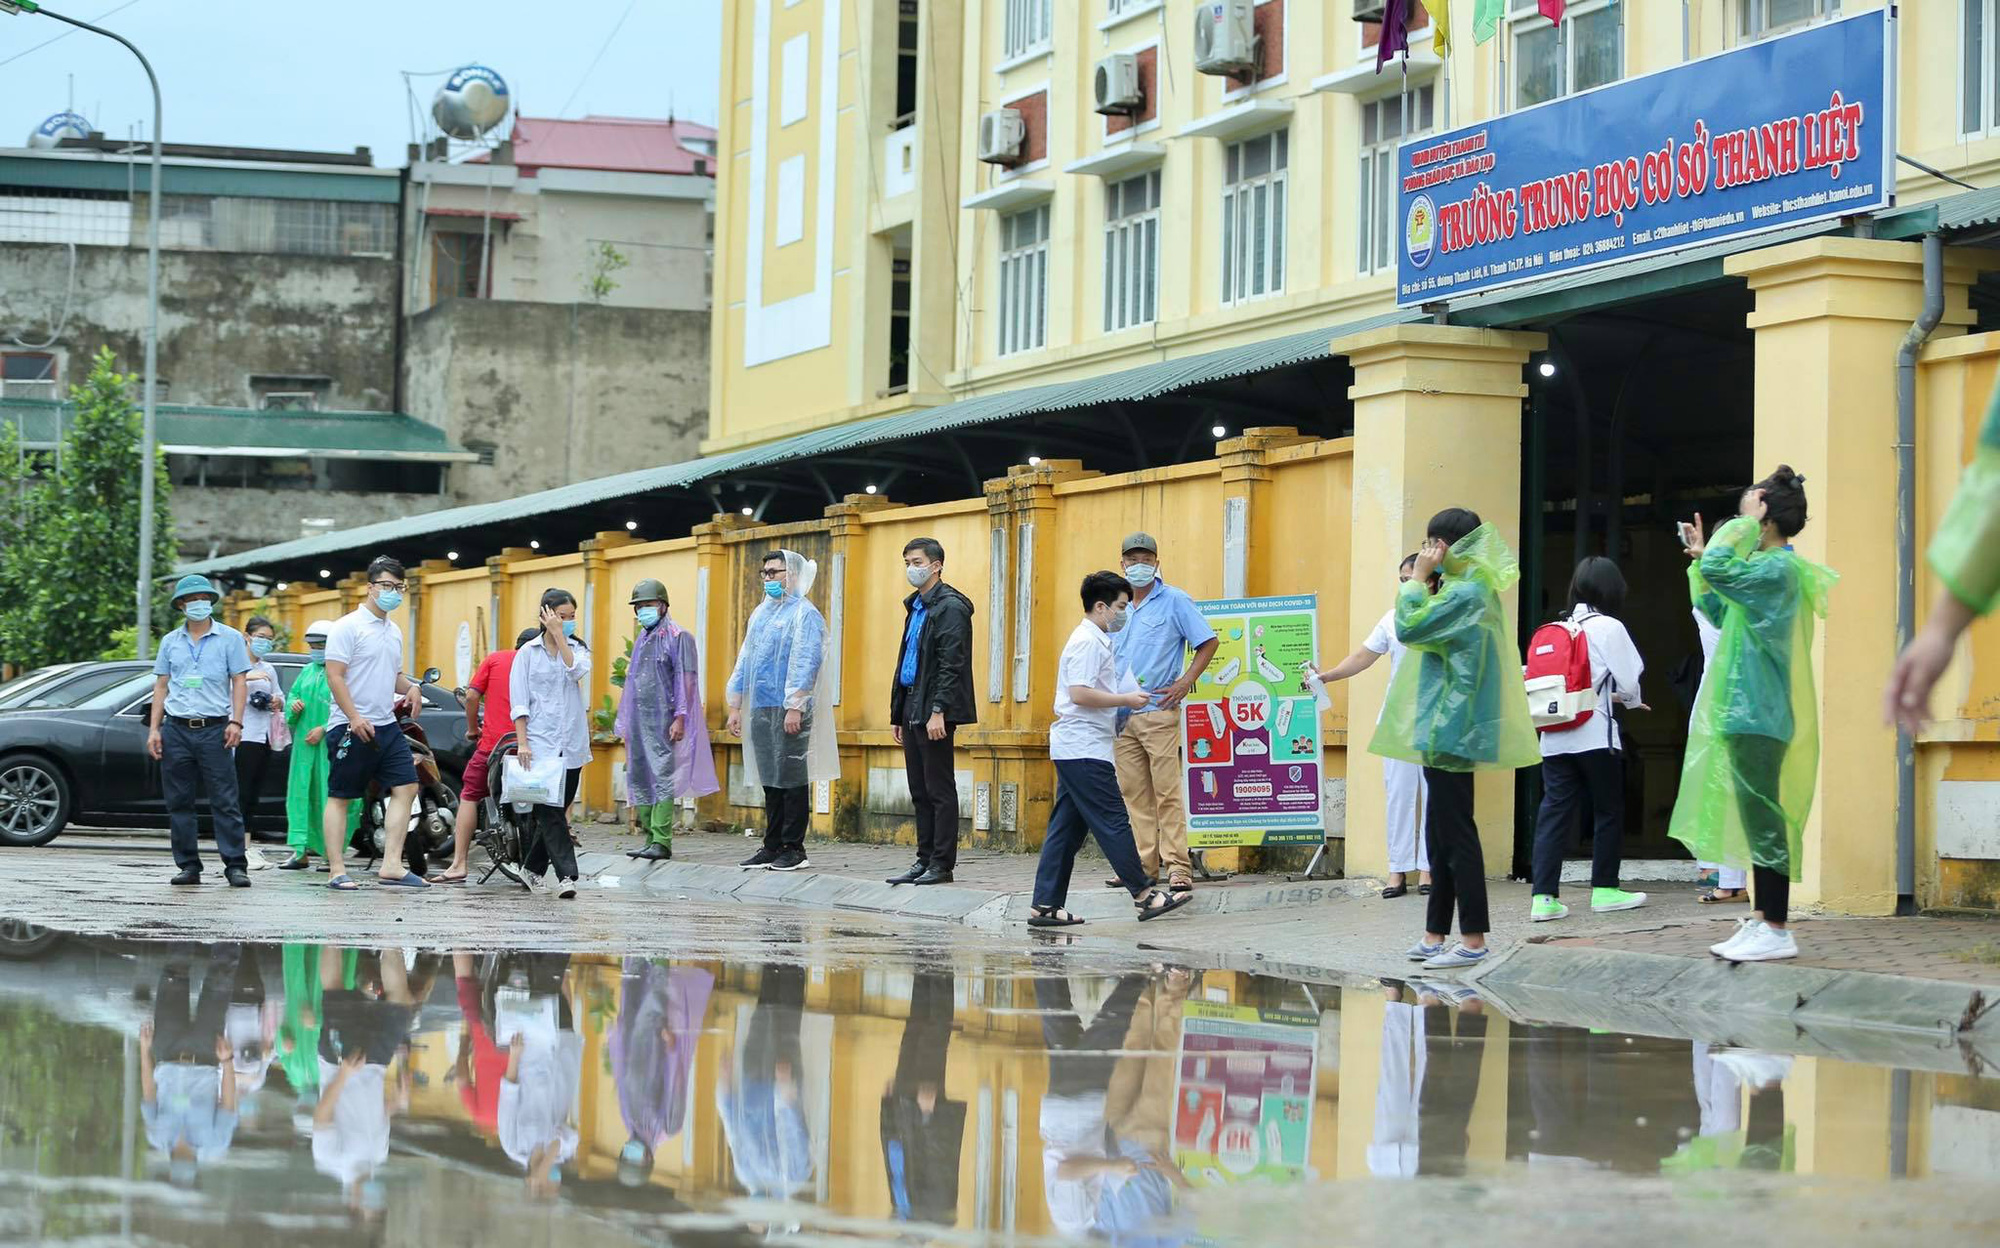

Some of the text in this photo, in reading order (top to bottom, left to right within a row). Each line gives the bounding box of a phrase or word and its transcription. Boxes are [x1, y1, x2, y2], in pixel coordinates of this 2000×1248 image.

[1452, 138, 1475, 159] THANH
[1438, 182, 1516, 253] TRƯỜNG
[1520, 170, 1590, 235] TRUNG
[1593, 156, 1639, 228] HỌC
[1642, 138, 1674, 205] CƠ
[1677, 119, 1709, 198] SỞ
[1712, 116, 1800, 189] THANH
[1803, 90, 1864, 179] LIỆT
[1751, 202, 1782, 219] Website:
[1237, 702, 1265, 722] 5K
[1235, 785, 1270, 793] 19009095
